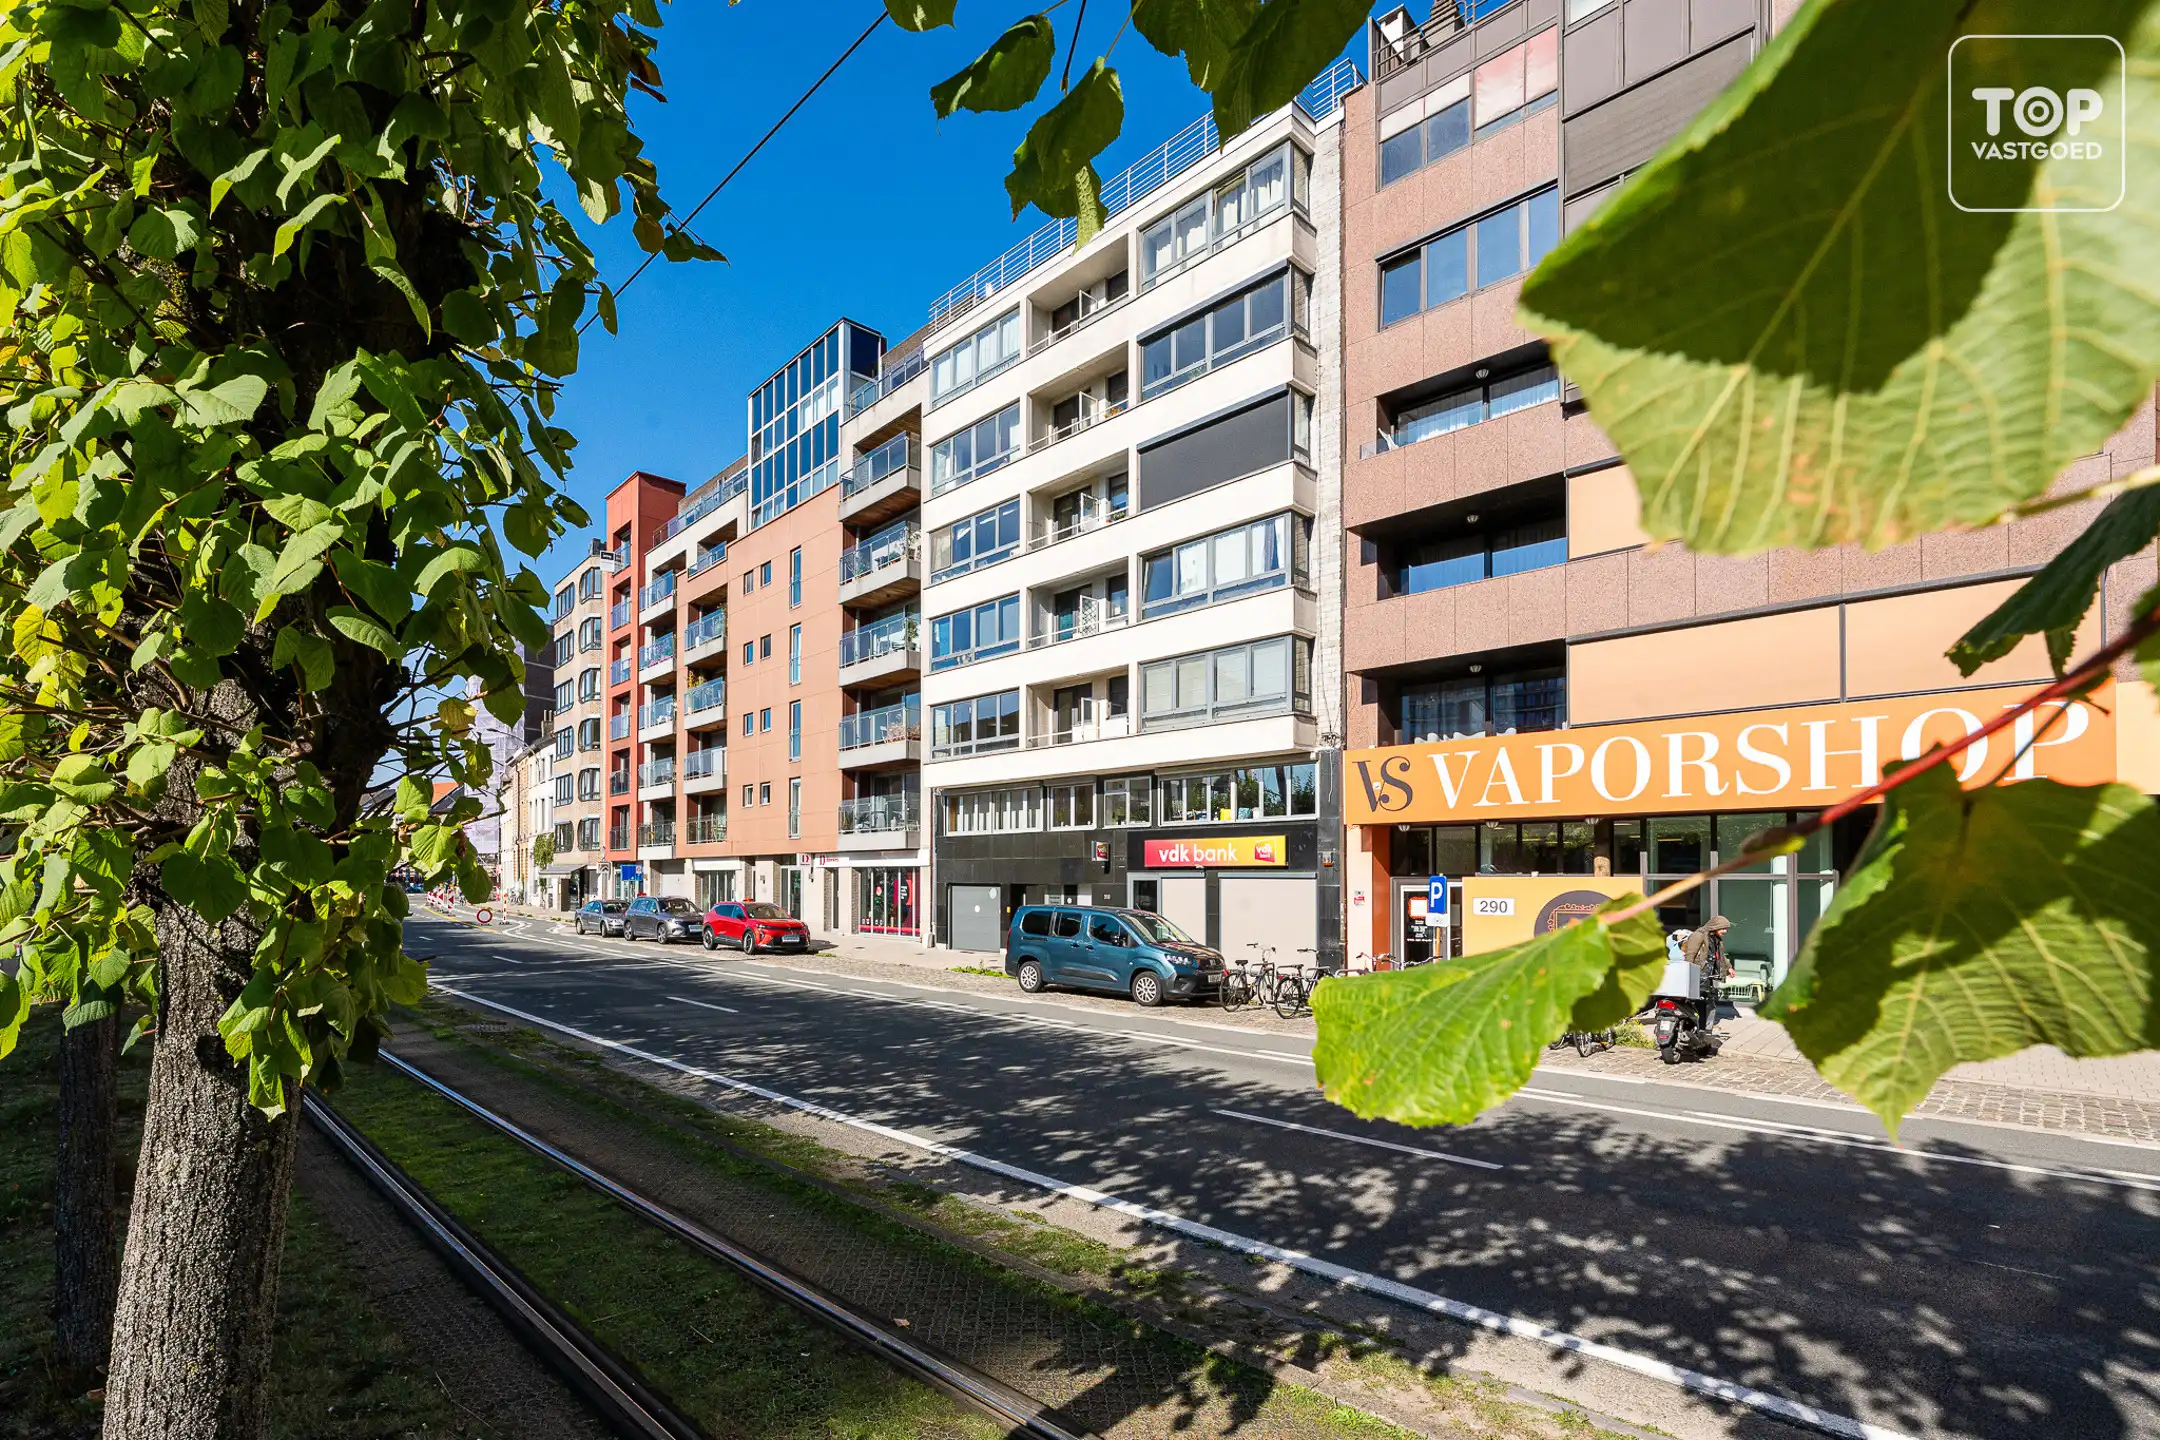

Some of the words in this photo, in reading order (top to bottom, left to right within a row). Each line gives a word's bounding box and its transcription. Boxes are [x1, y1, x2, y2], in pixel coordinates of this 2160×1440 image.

[1352, 755, 1413, 813] VS
[1427, 700, 2089, 809] VAPORSHOP
[1158, 843, 1190, 863] vdk
[1193, 842, 1238, 862] bank
[1430, 882, 1443, 908] P
[1479, 900, 1508, 913] 290
